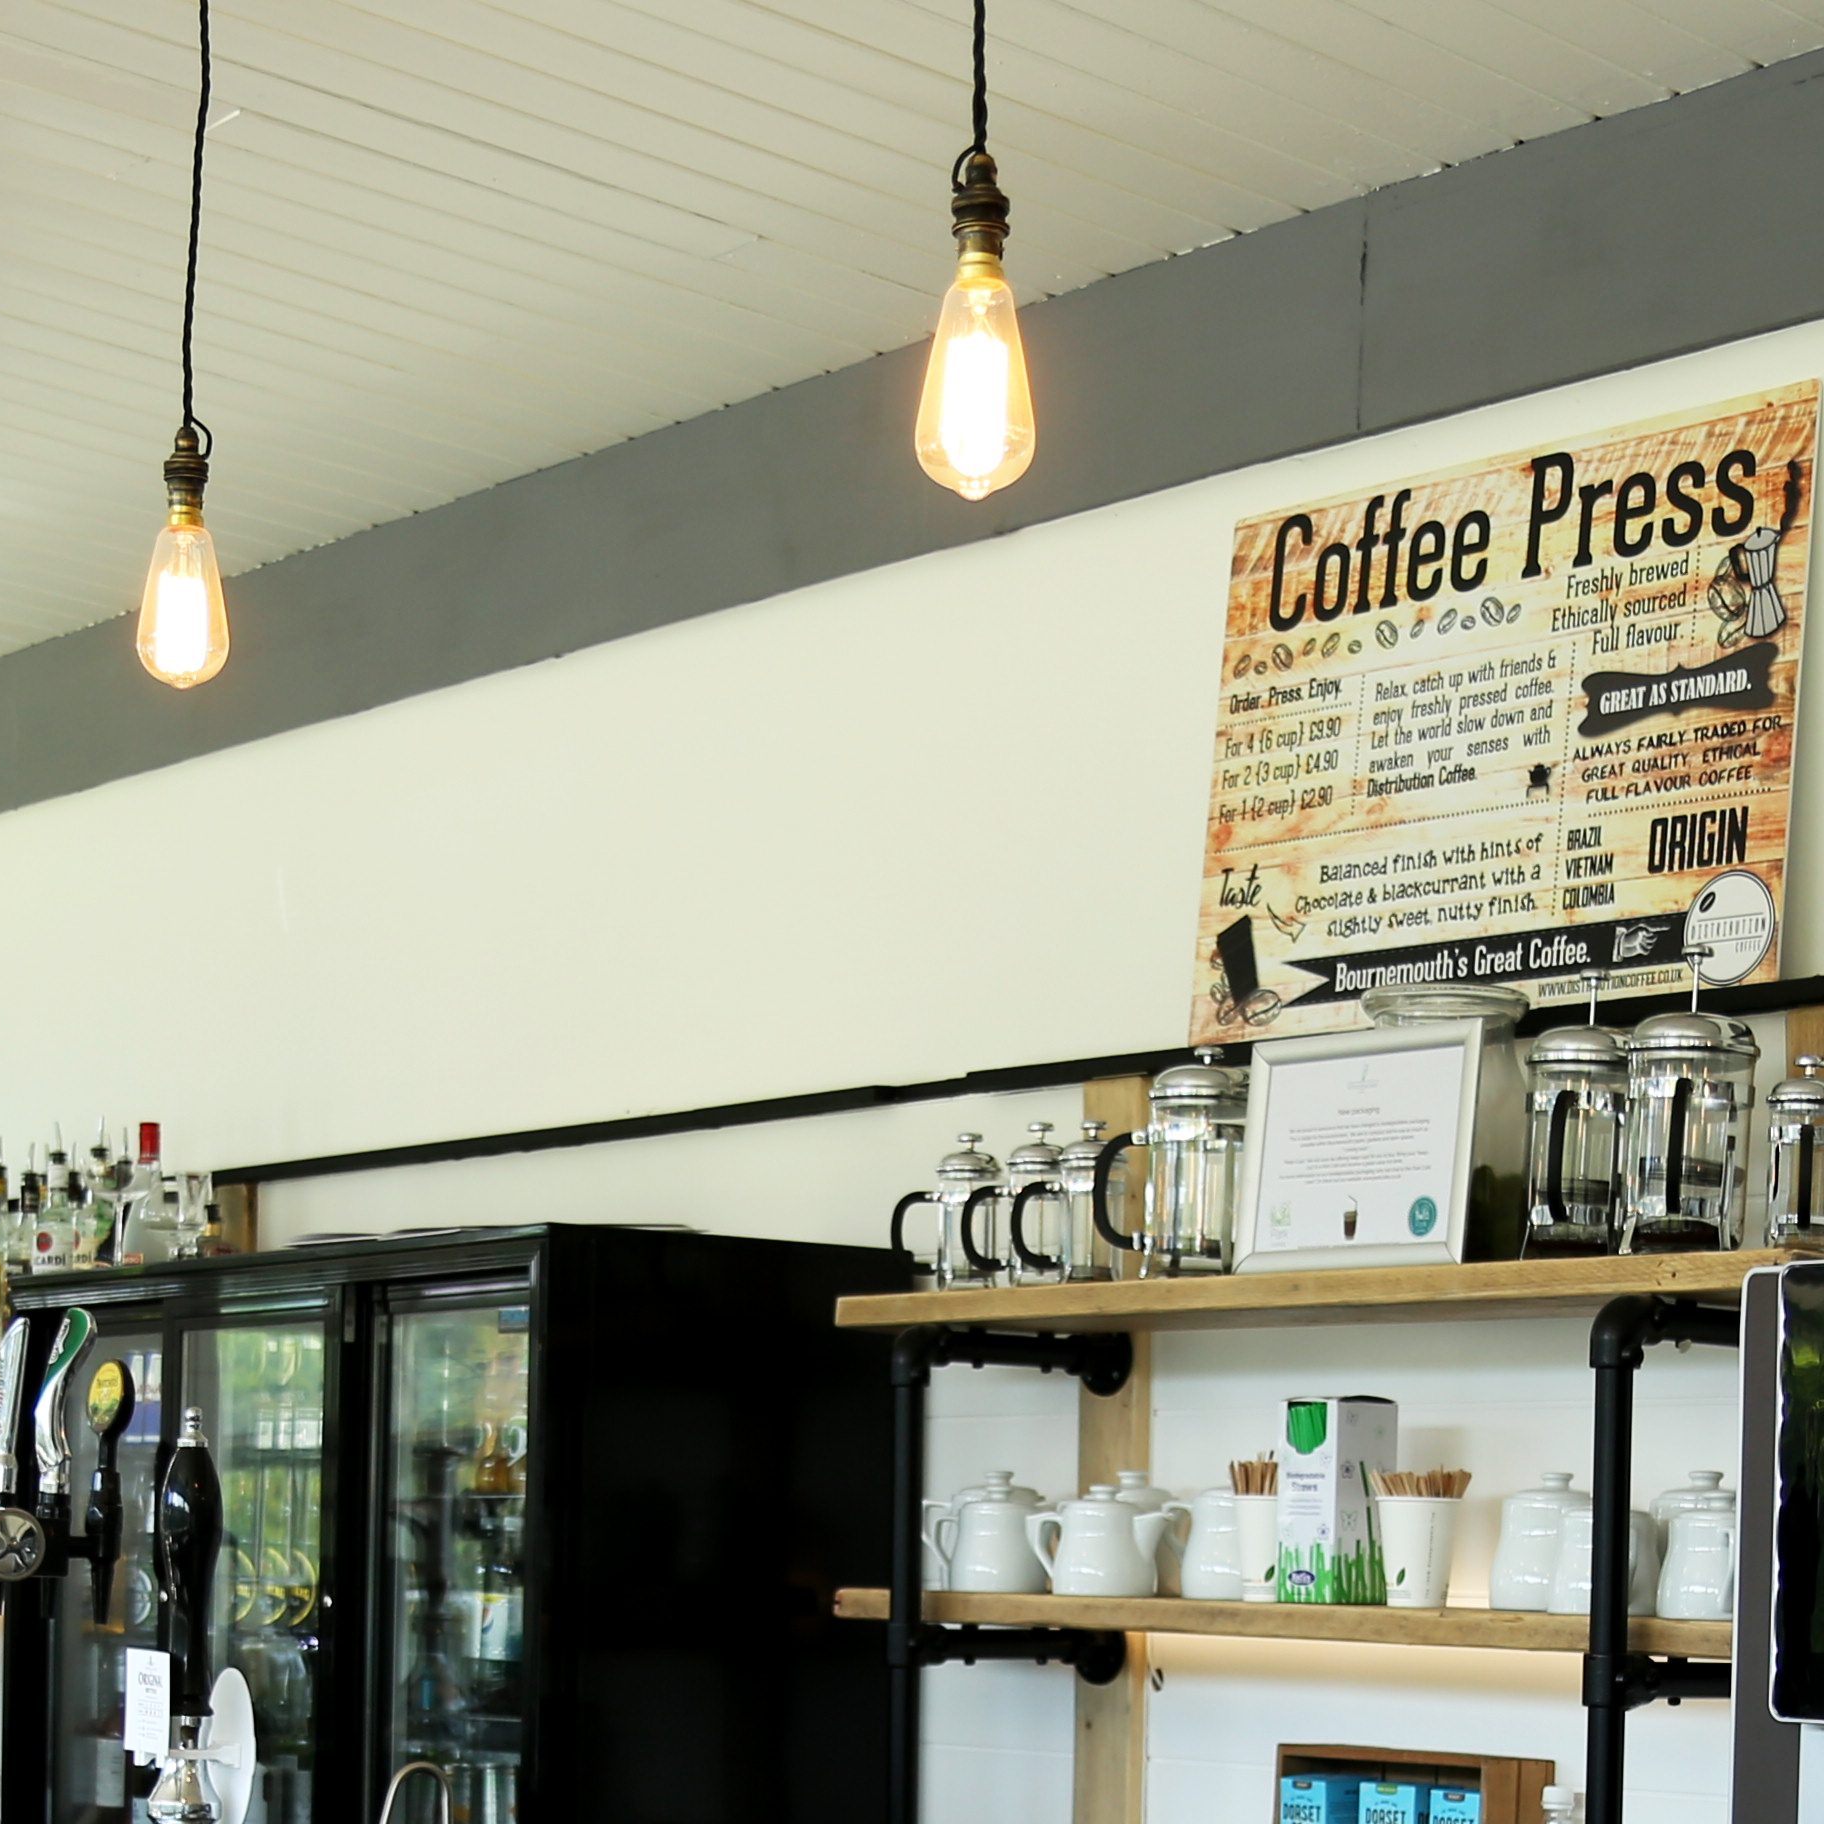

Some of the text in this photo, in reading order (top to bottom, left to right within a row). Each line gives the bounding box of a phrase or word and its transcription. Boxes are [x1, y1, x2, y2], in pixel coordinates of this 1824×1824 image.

[1268, 449, 1757, 632] Coffee Press
[1566, 552, 1689, 599] Freshly brewed
[1551, 583, 1687, 633] Ethically sourced
[1592, 621, 1684, 655] Full flavour.
[1309, 678, 1342, 703] Enjoy.
[1412, 674, 1445, 695] catch
[1448, 671, 1464, 692] up
[1467, 664, 1496, 685] with
[1499, 655, 1544, 679] friends
[1547, 650, 1557, 669] &
[1599, 668, 1752, 715] GREAT AS STANDARD.
[1371, 700, 1554, 750] Let the world slow down and
[1373, 705, 1404, 728] enjoy
[1410, 694, 1452, 719] freshly
[1459, 684, 1508, 713] pressed
[1225, 737, 1243, 758] For
[1247, 734, 1255, 754] 4
[1309, 716, 1341, 742] £9.90
[1369, 727, 1552, 775] awaken your senses with
[1573, 714, 1784, 762] ALWAYS FAIRLY TRADED FOR
[1221, 769, 1240, 790] For
[1244, 766, 1252, 786] 2
[1305, 750, 1339, 773] £4.90
[1366, 771, 1435, 798] Distribution
[1581, 761, 1626, 783] GREAT
[1586, 782, 1619, 804] FULL
[1626, 775, 1692, 799] FLAVOUR
[1219, 804, 1236, 825] For
[1241, 801, 1248, 820] 1
[1300, 785, 1333, 810] £2.90
[1319, 832, 1544, 885] Balanced finish with hints of
[1567, 806, 1749, 874] BRAZIL ORIGIN
[1219, 864, 1262, 908] Taste
[1565, 853, 1613, 880] VIETNAM
[1295, 864, 1542, 915] Chocolate & blackcurrant with a
[1562, 882, 1615, 910] COLOMBIA
[1326, 912, 1383, 939] slightly
[1437, 901, 1484, 923] nutty
[1691, 917, 1766, 940] DISTRIBUTION
[1334, 934, 1591, 993] Bournemouth's Great Coffee.
[1735, 940, 1761, 953] COFFEE
[1282, 1803, 1321, 1823] DORSET
